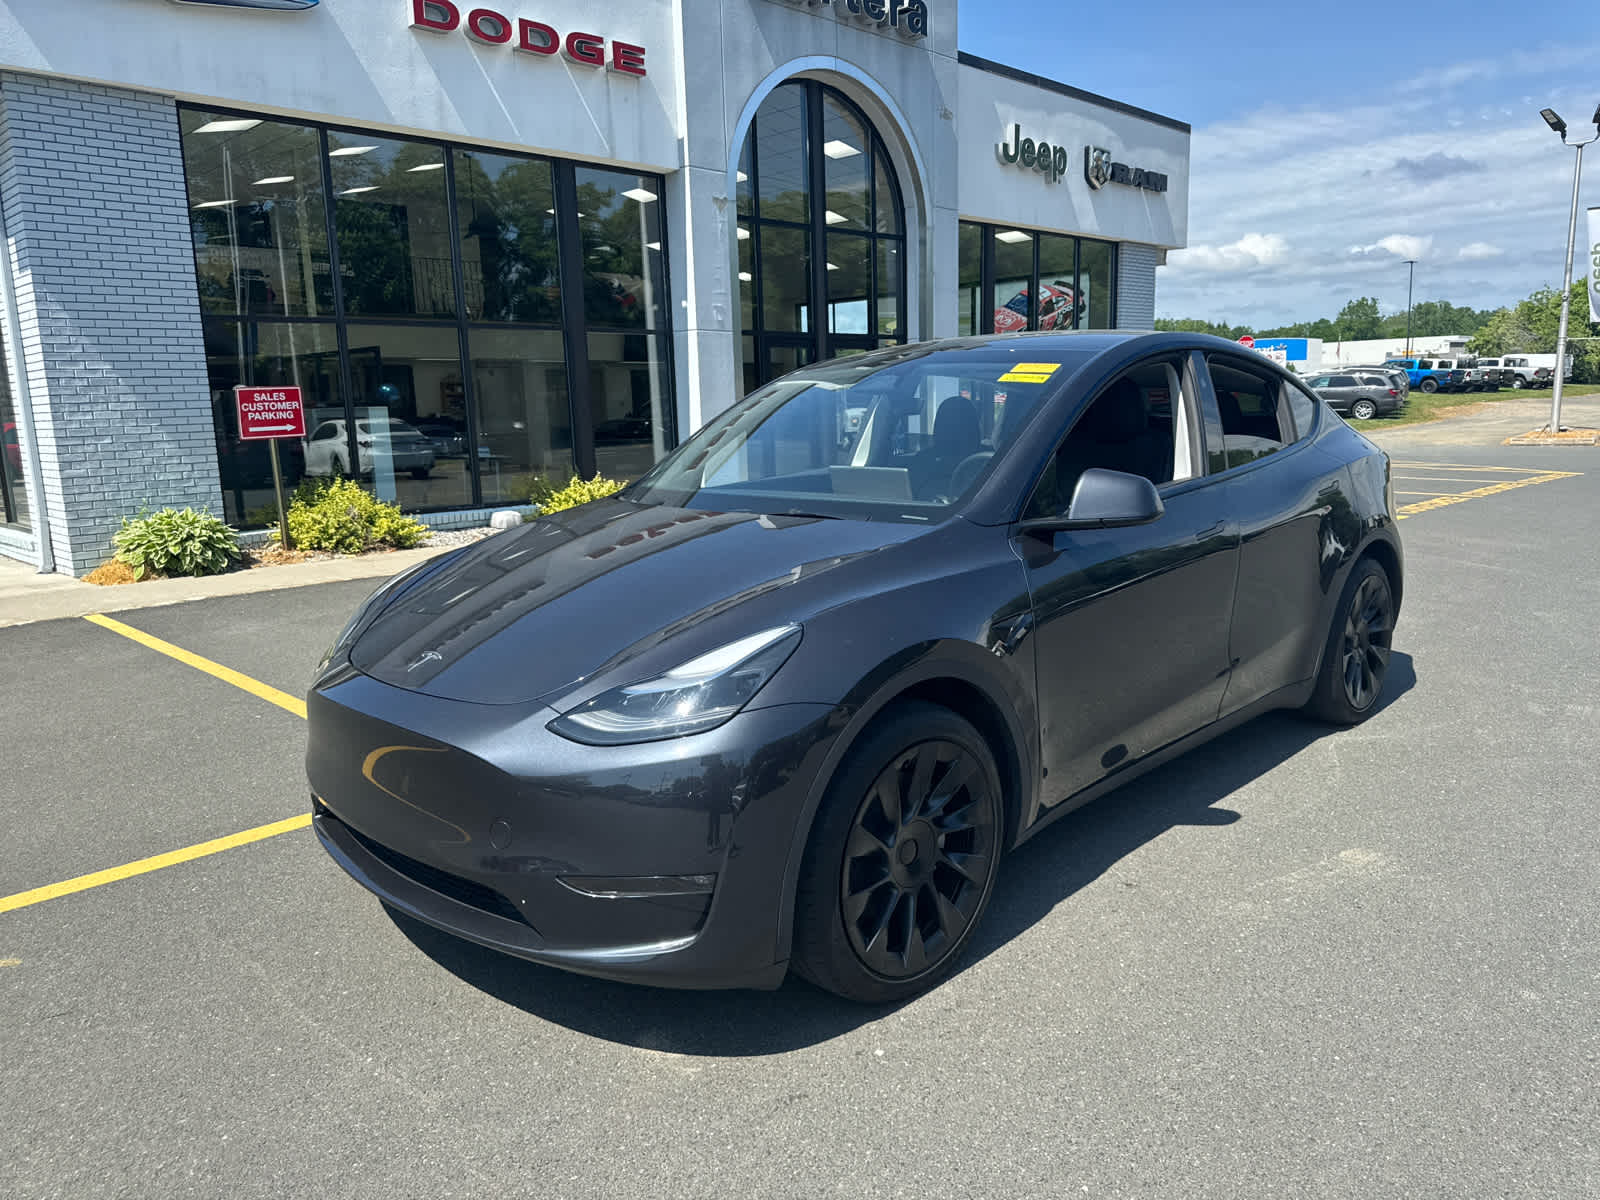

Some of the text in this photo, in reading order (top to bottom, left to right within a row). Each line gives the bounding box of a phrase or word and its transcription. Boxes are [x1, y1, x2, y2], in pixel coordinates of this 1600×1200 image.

[412, 0, 647, 77] DODGE
[1000, 122, 1068, 184] Jeep
[1111, 162, 1168, 192] RAM
[241, 401, 300, 411] CUSTOMER
[253, 392, 286, 401] SALES
[248, 411, 294, 420] PARKING
